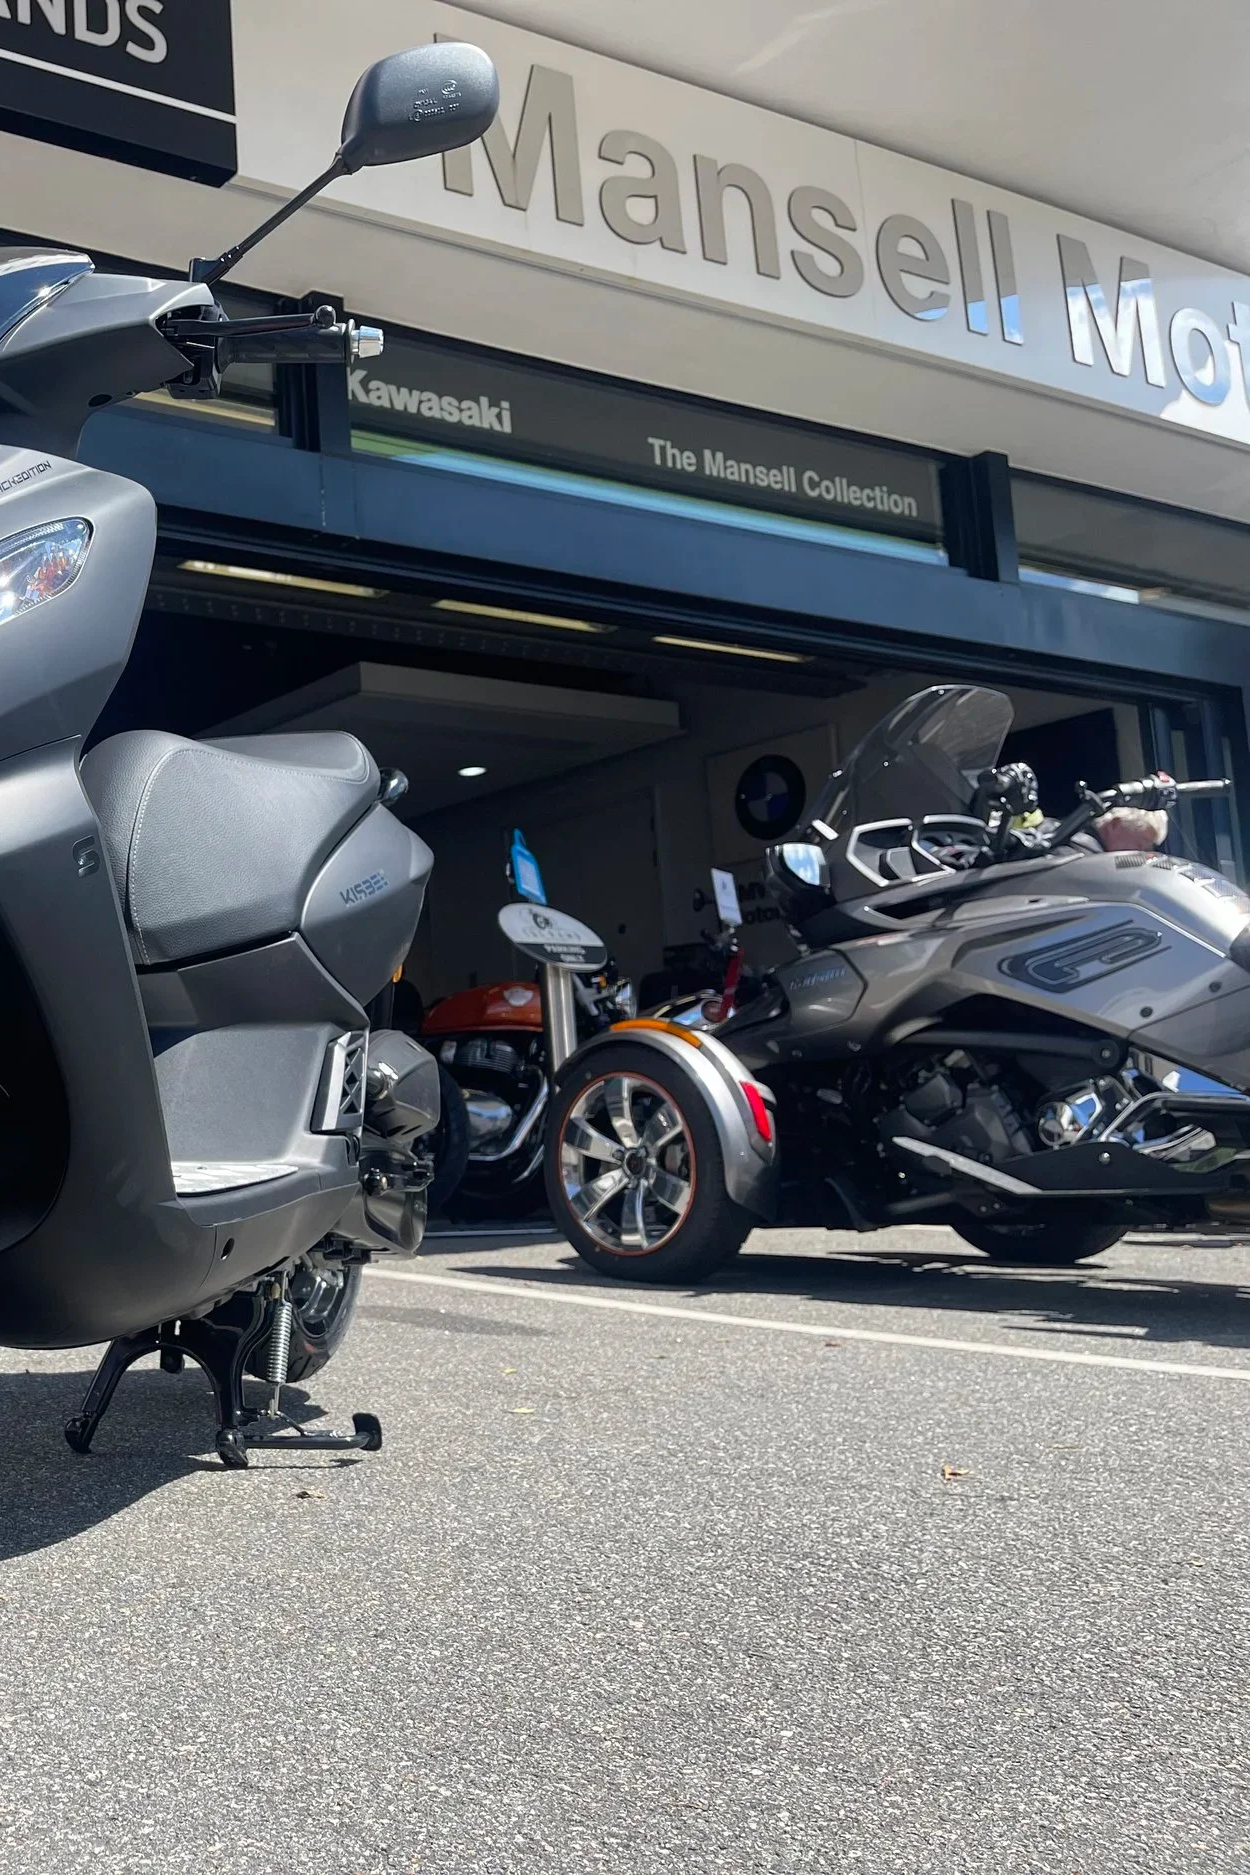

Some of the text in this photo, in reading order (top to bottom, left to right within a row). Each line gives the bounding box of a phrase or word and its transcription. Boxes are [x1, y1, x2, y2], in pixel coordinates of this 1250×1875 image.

[434, 33, 1024, 346] Mansell
[346, 366, 513, 434] Kawasaki
[647, 437, 919, 518] The Mansell Collection
